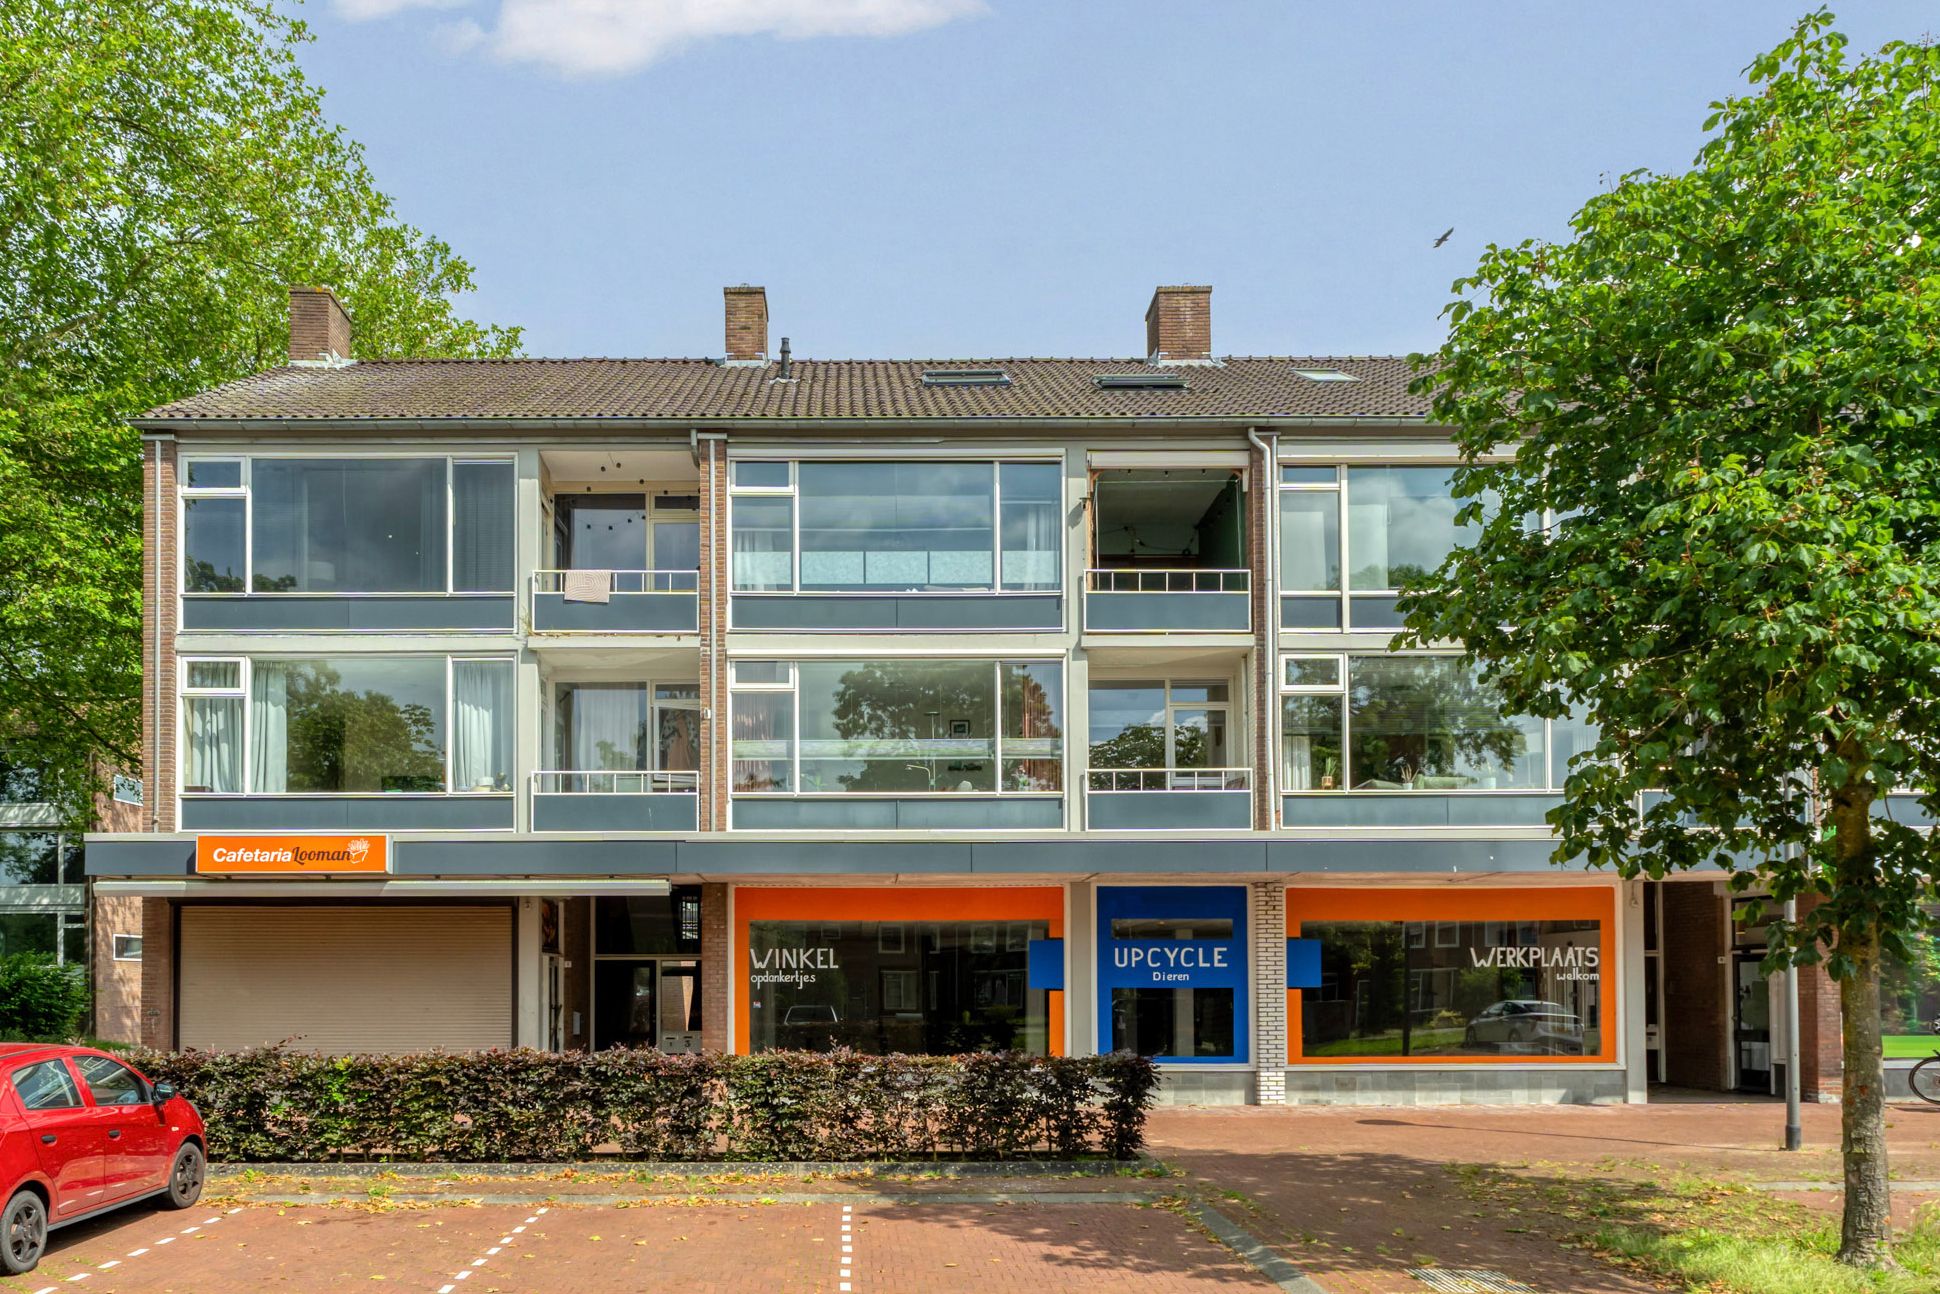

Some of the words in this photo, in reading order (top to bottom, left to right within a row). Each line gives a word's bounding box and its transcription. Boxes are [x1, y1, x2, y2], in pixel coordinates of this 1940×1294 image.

[213, 847, 293, 863] Cafetaria
[292, 847, 351, 866] Looman
[750, 948, 839, 969] WINKEL
[1114, 947, 1228, 968] UPCYCLE
[1470, 947, 1599, 968] WERKPLAATS
[750, 969, 816, 990] opdankertjes
[1152, 971, 1190, 981] Dieren
[1556, 967, 1600, 981] welkom
